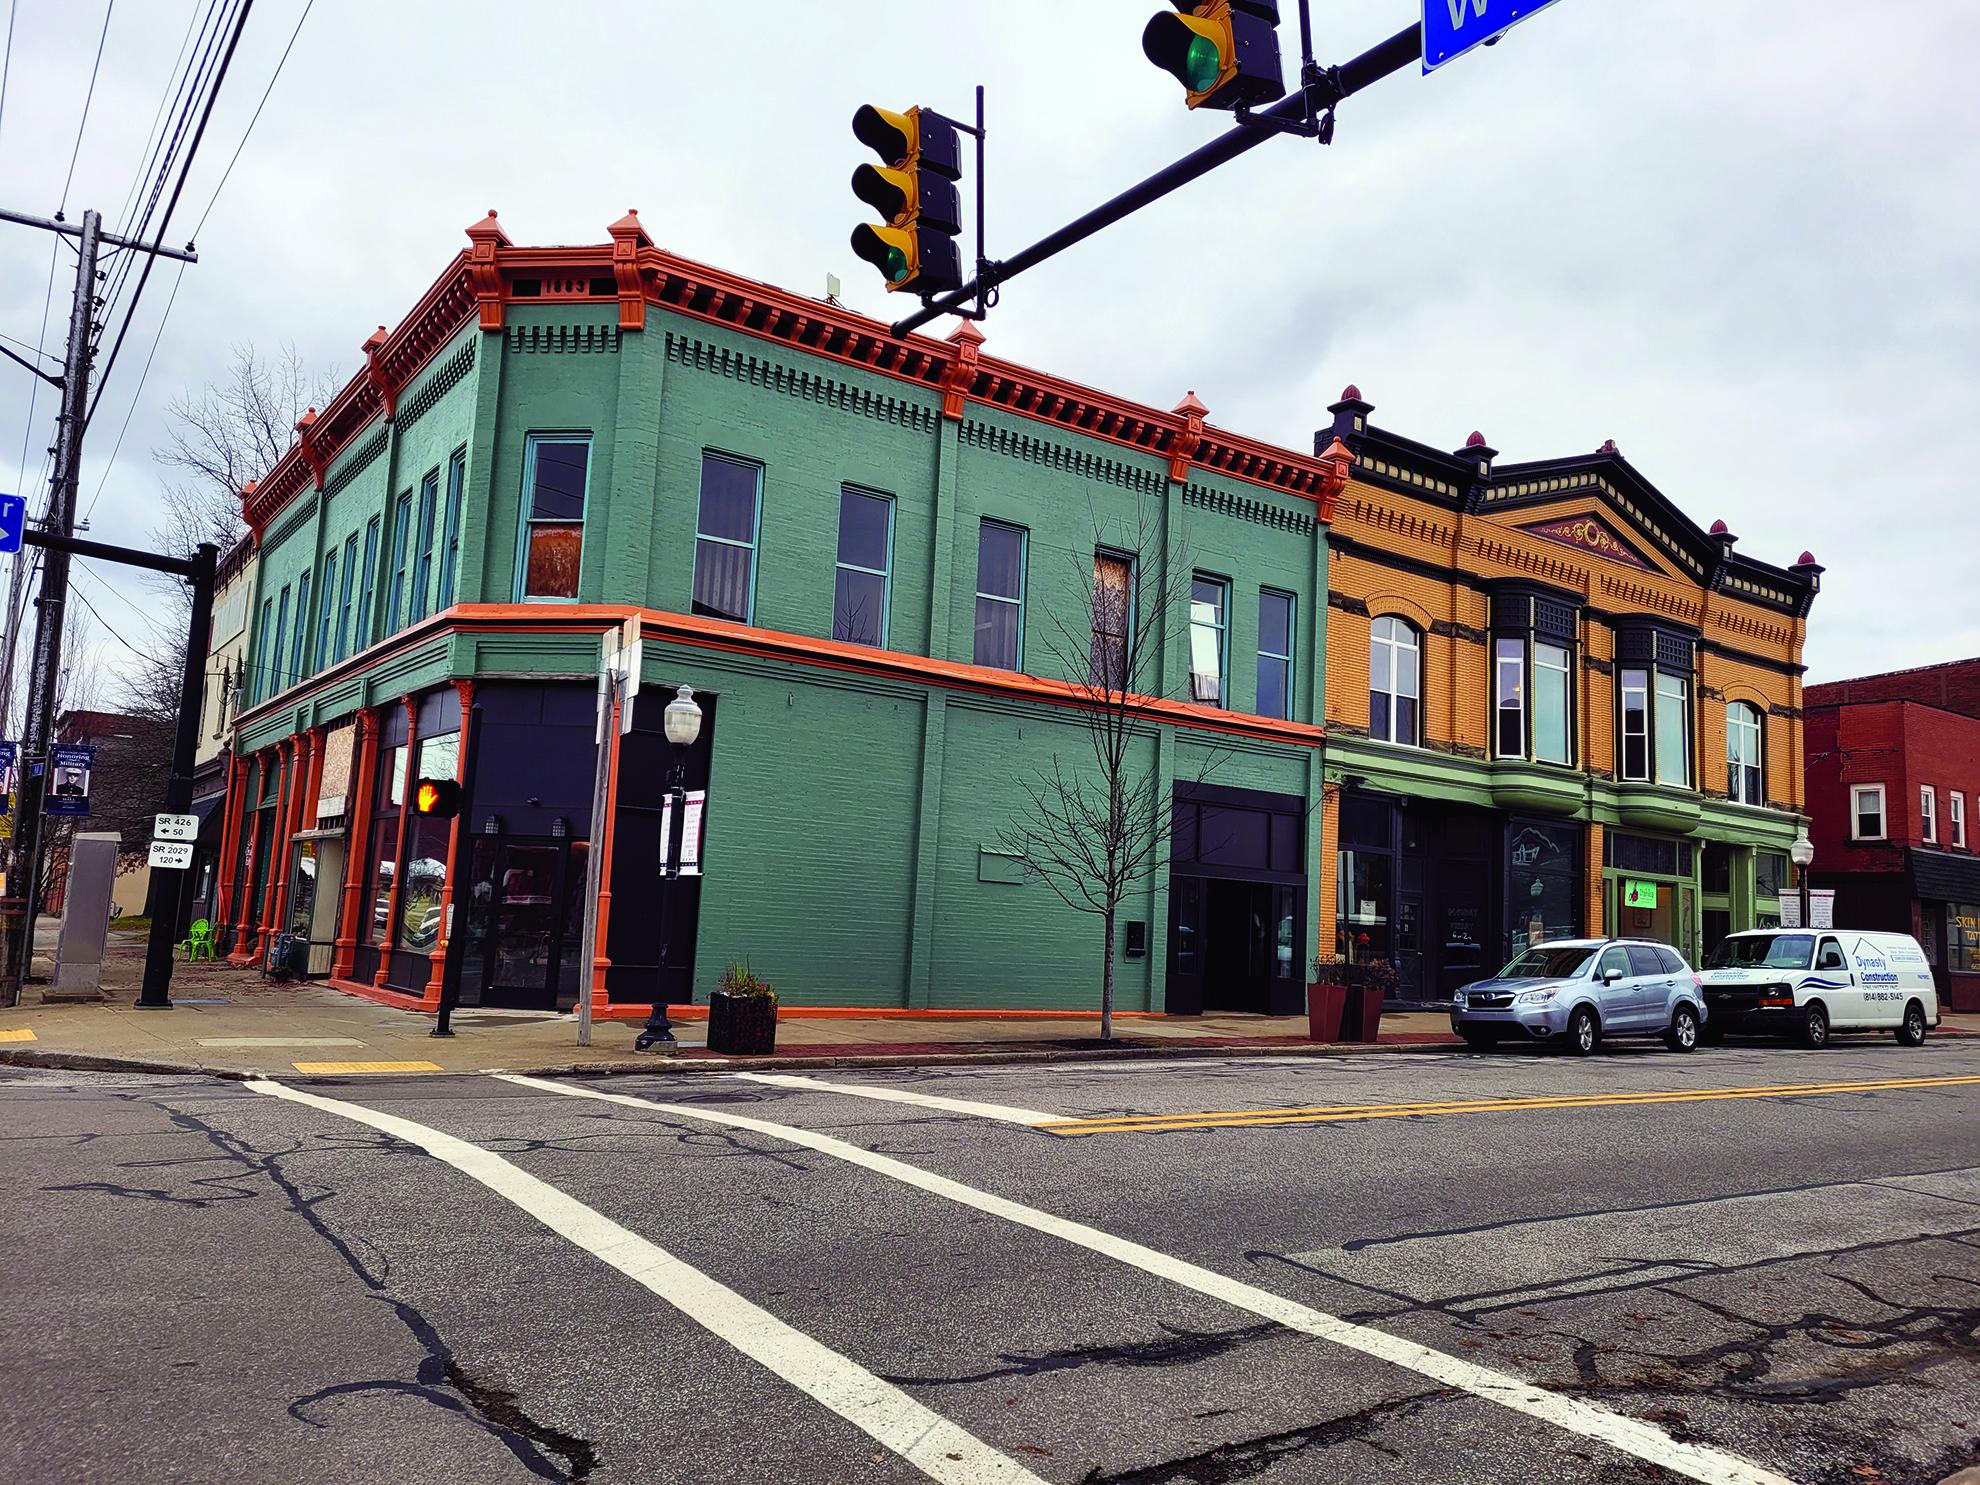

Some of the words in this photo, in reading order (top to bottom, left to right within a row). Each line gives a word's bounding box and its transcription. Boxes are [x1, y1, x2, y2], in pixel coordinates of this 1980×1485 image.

[57, 753, 90, 761] Honoring
[60, 760, 86, 768] Military
[158, 817, 171, 825] SR
[174, 818, 192, 827] 426
[172, 828, 184, 836] 50
[152, 845, 166, 853] SR
[167, 846, 189, 855] 2029
[159, 856, 174, 864] 120
[1955, 916, 1976, 929] SKIN
[1855, 955, 1887, 970] Dynasty
[1861, 971, 1899, 981] Construction
